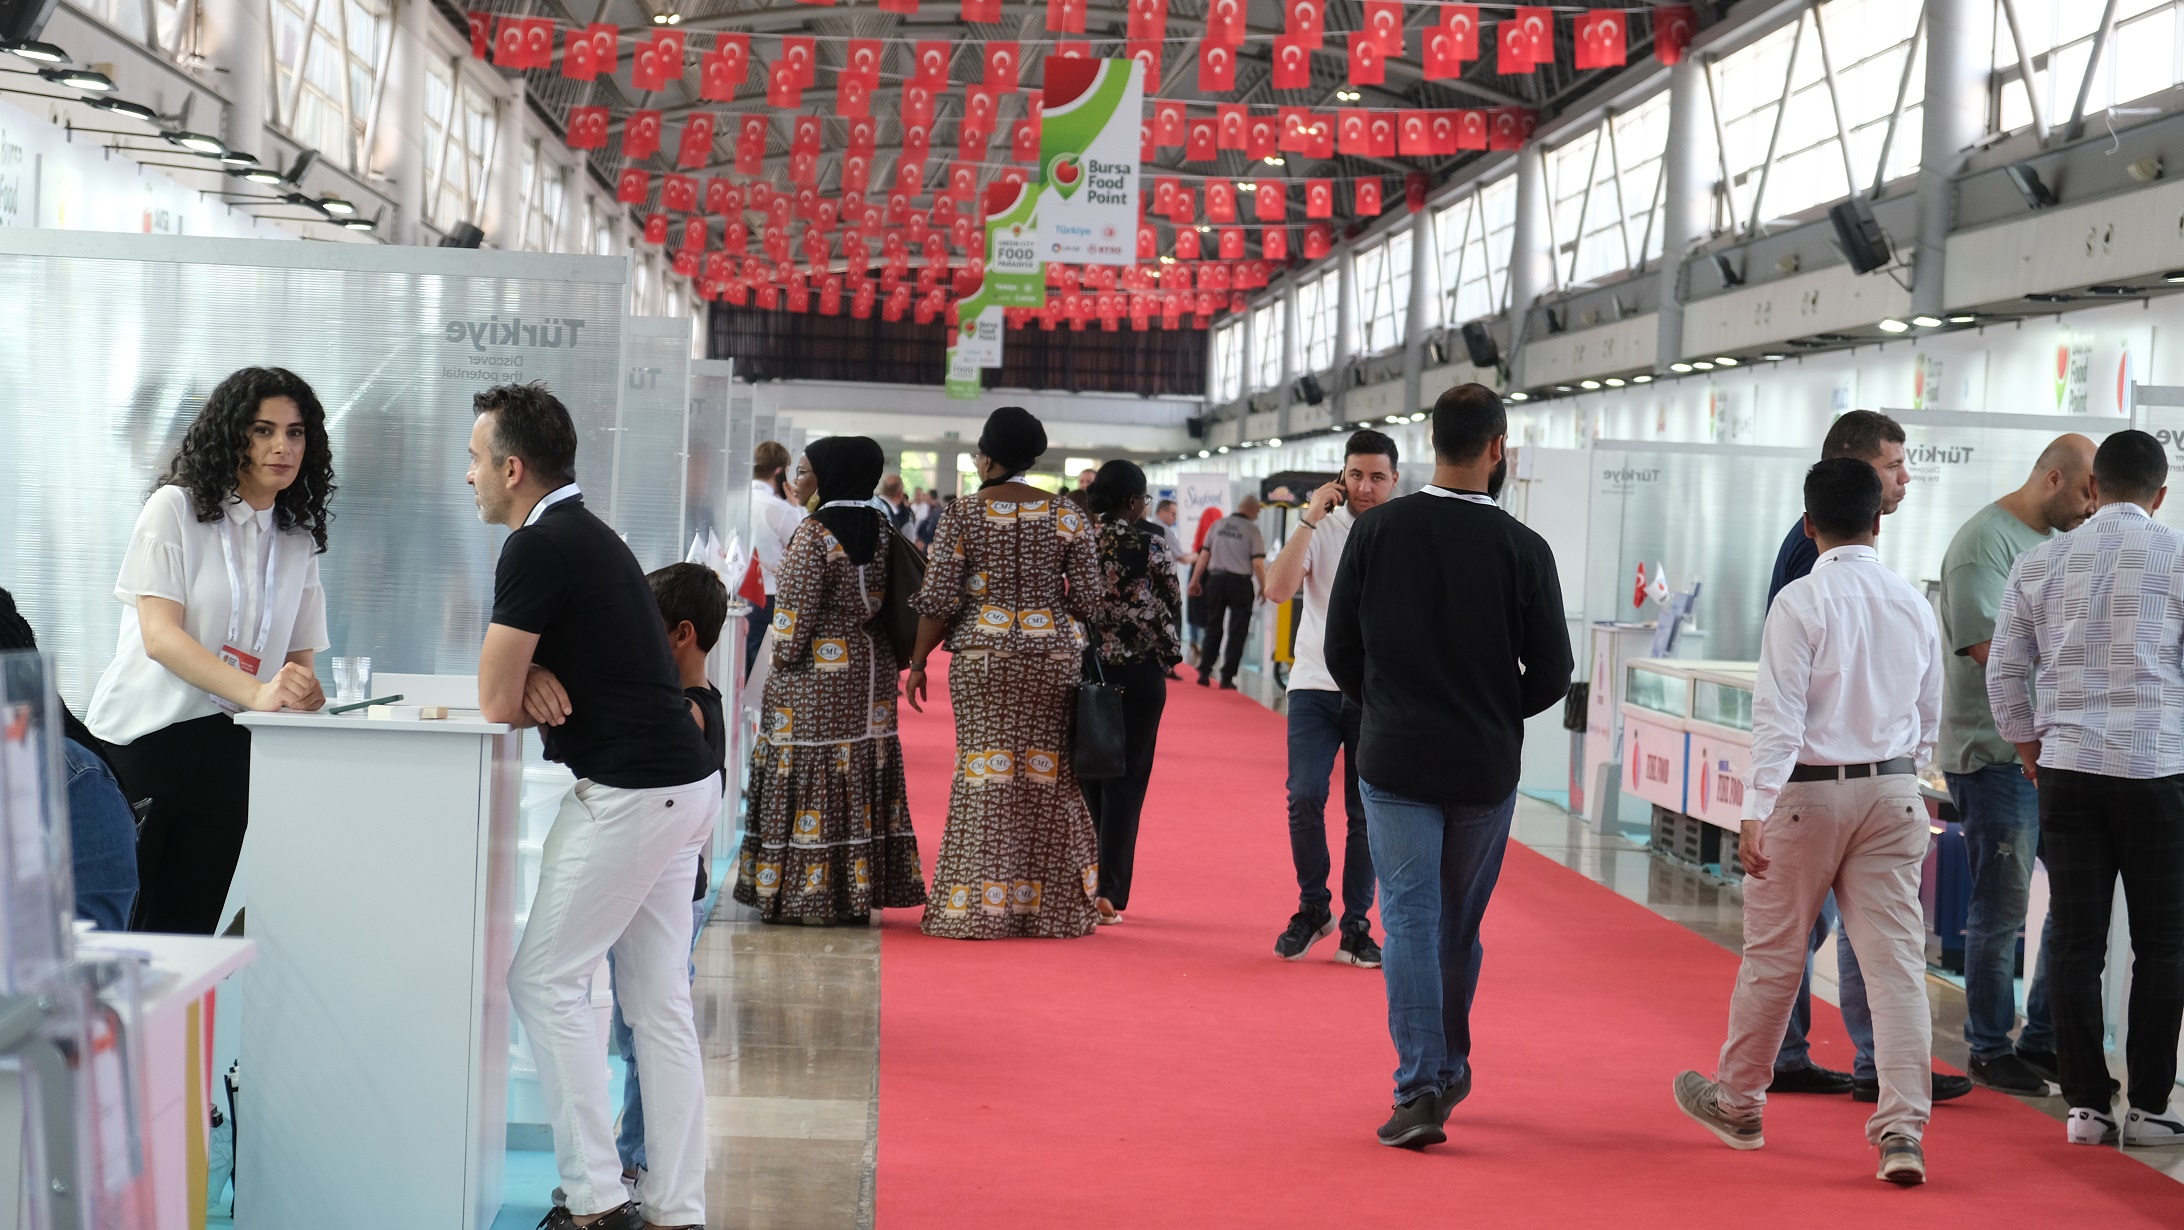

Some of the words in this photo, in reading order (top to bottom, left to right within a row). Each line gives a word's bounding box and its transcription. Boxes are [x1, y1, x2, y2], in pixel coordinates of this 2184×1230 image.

[1088, 159, 1131, 175] Bursa
[1087, 175, 1124, 189] Food
[1087, 190, 1127, 204] Point
[998, 248, 1034, 260] FOOD
[994, 502, 1013, 510] CML
[1064, 516, 1077, 526] CM
[986, 612, 1005, 622] CML
[820, 647, 839, 656] CML
[990, 758, 1008, 767] CML
[1031, 758, 1049, 768] CML
[987, 891, 1001, 899] CML
